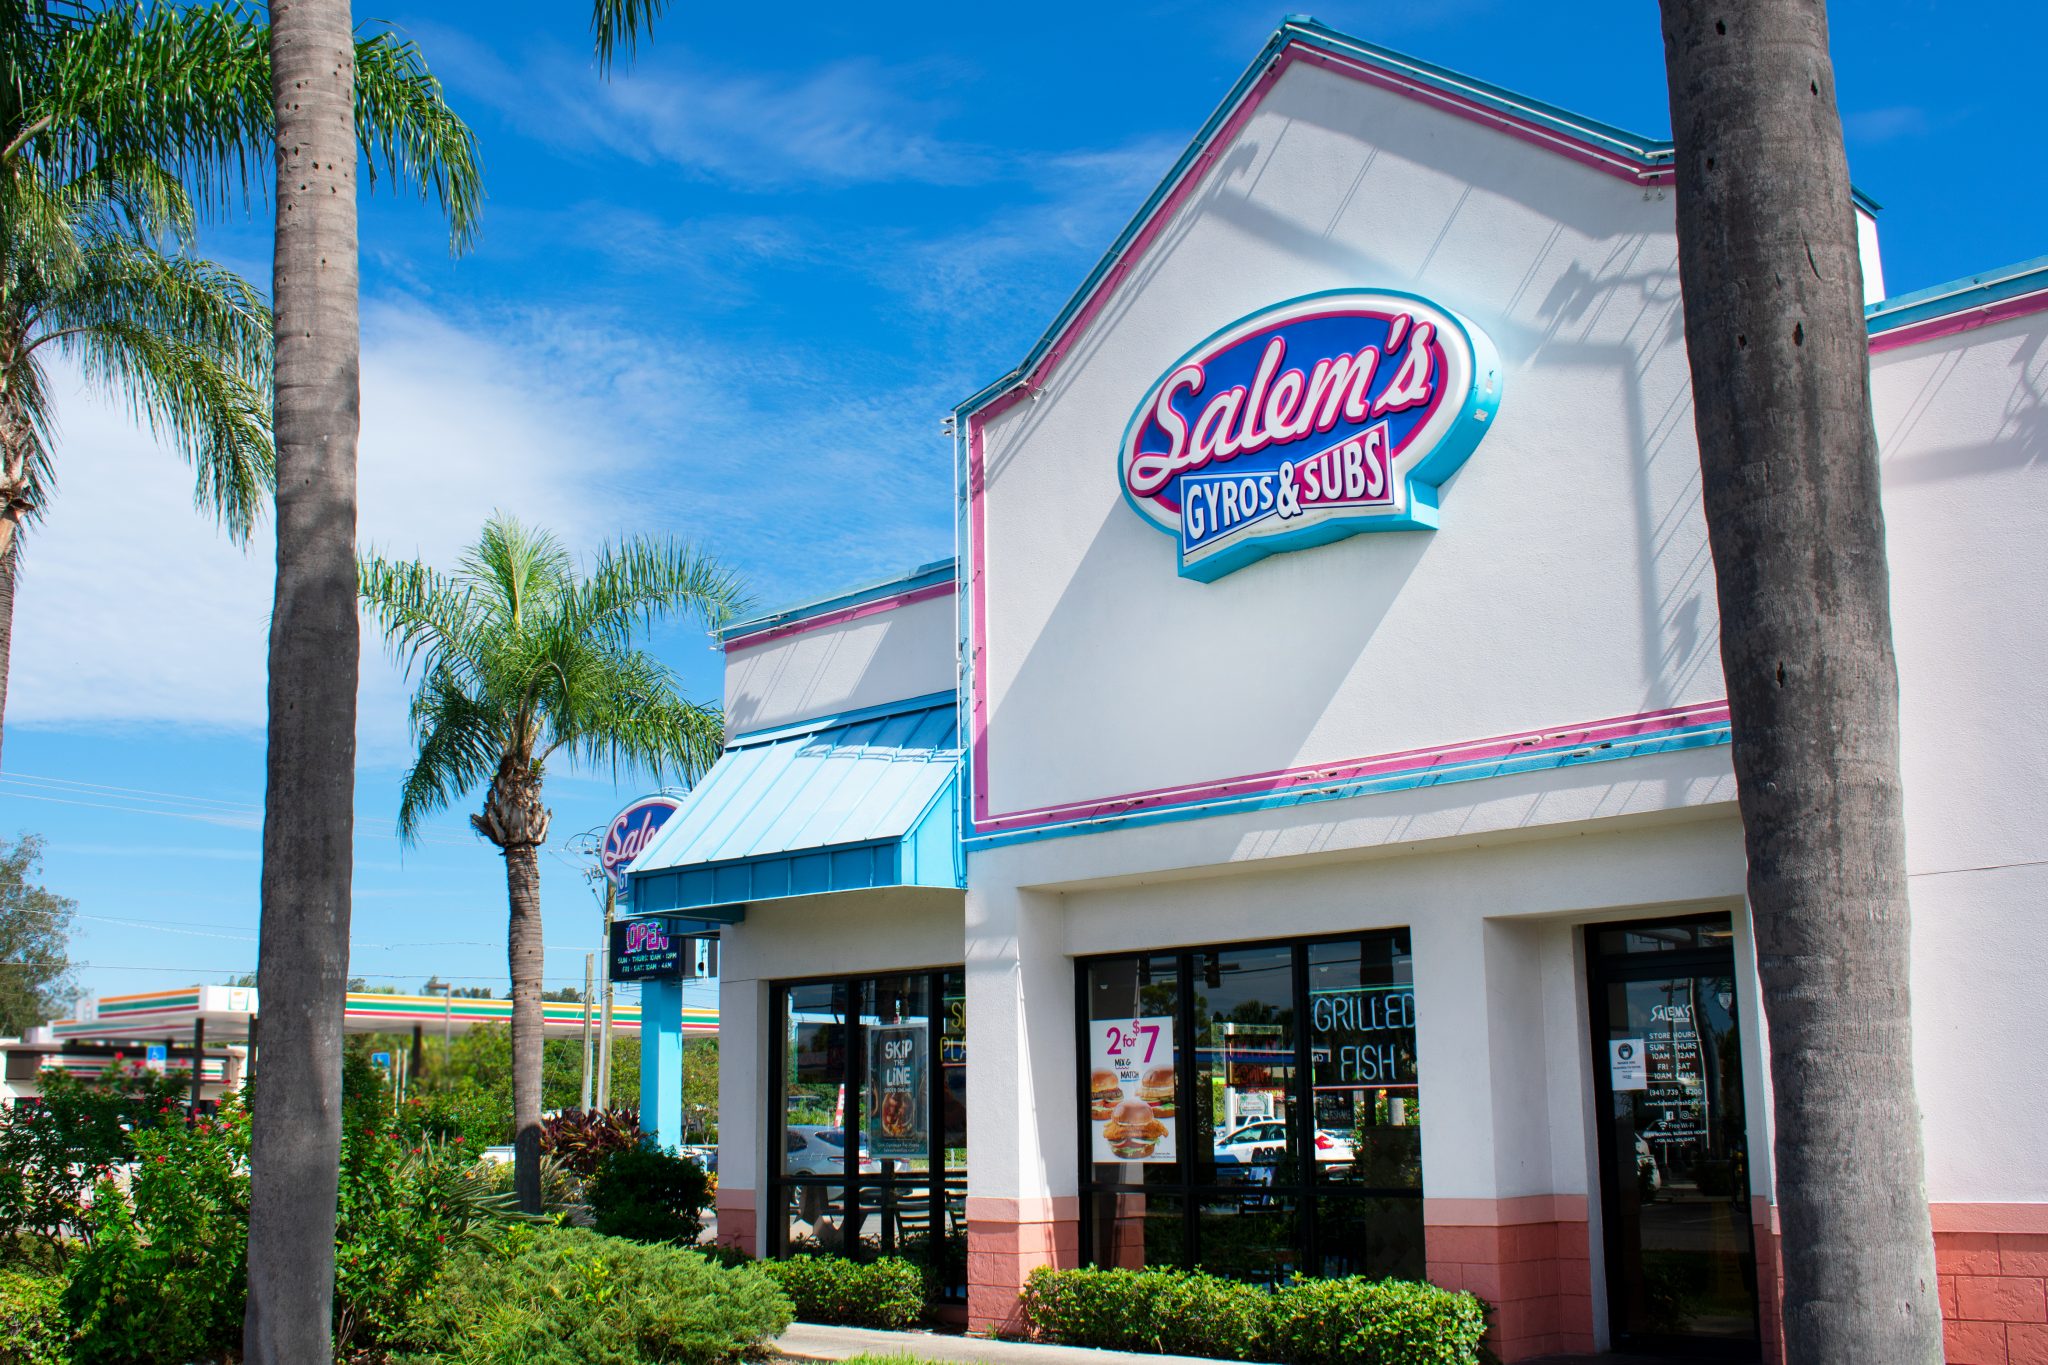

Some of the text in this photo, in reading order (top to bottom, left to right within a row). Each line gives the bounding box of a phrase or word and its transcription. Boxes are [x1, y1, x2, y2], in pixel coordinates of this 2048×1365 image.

[1129, 312, 1437, 498] Salem's
[1185, 430, 1385, 540] GYROS & SUBS
[603, 810, 660, 869] Sale
[626, 922, 670, 952] OPEN
[1313, 992, 1415, 1032] GRILLED
[1650, 1004, 1693, 1022] SALEM'S
[1106, 1026, 1122, 1055] 2
[1122, 1034, 1137, 1048] for
[1649, 1032, 1671, 1040] STORE
[1649, 1043, 1665, 1051] SUN
[1672, 1042, 1697, 1050] THURS
[1340, 1043, 1397, 1082] FISH
[1652, 1052, 1670, 1060] 10AM
[1657, 1063, 1669, 1071] FRI
[1677, 1062, 1691, 1070] SAT
[1120, 1070, 1140, 1080] MATCH
[1654, 1072, 1672, 1080] 10AM
